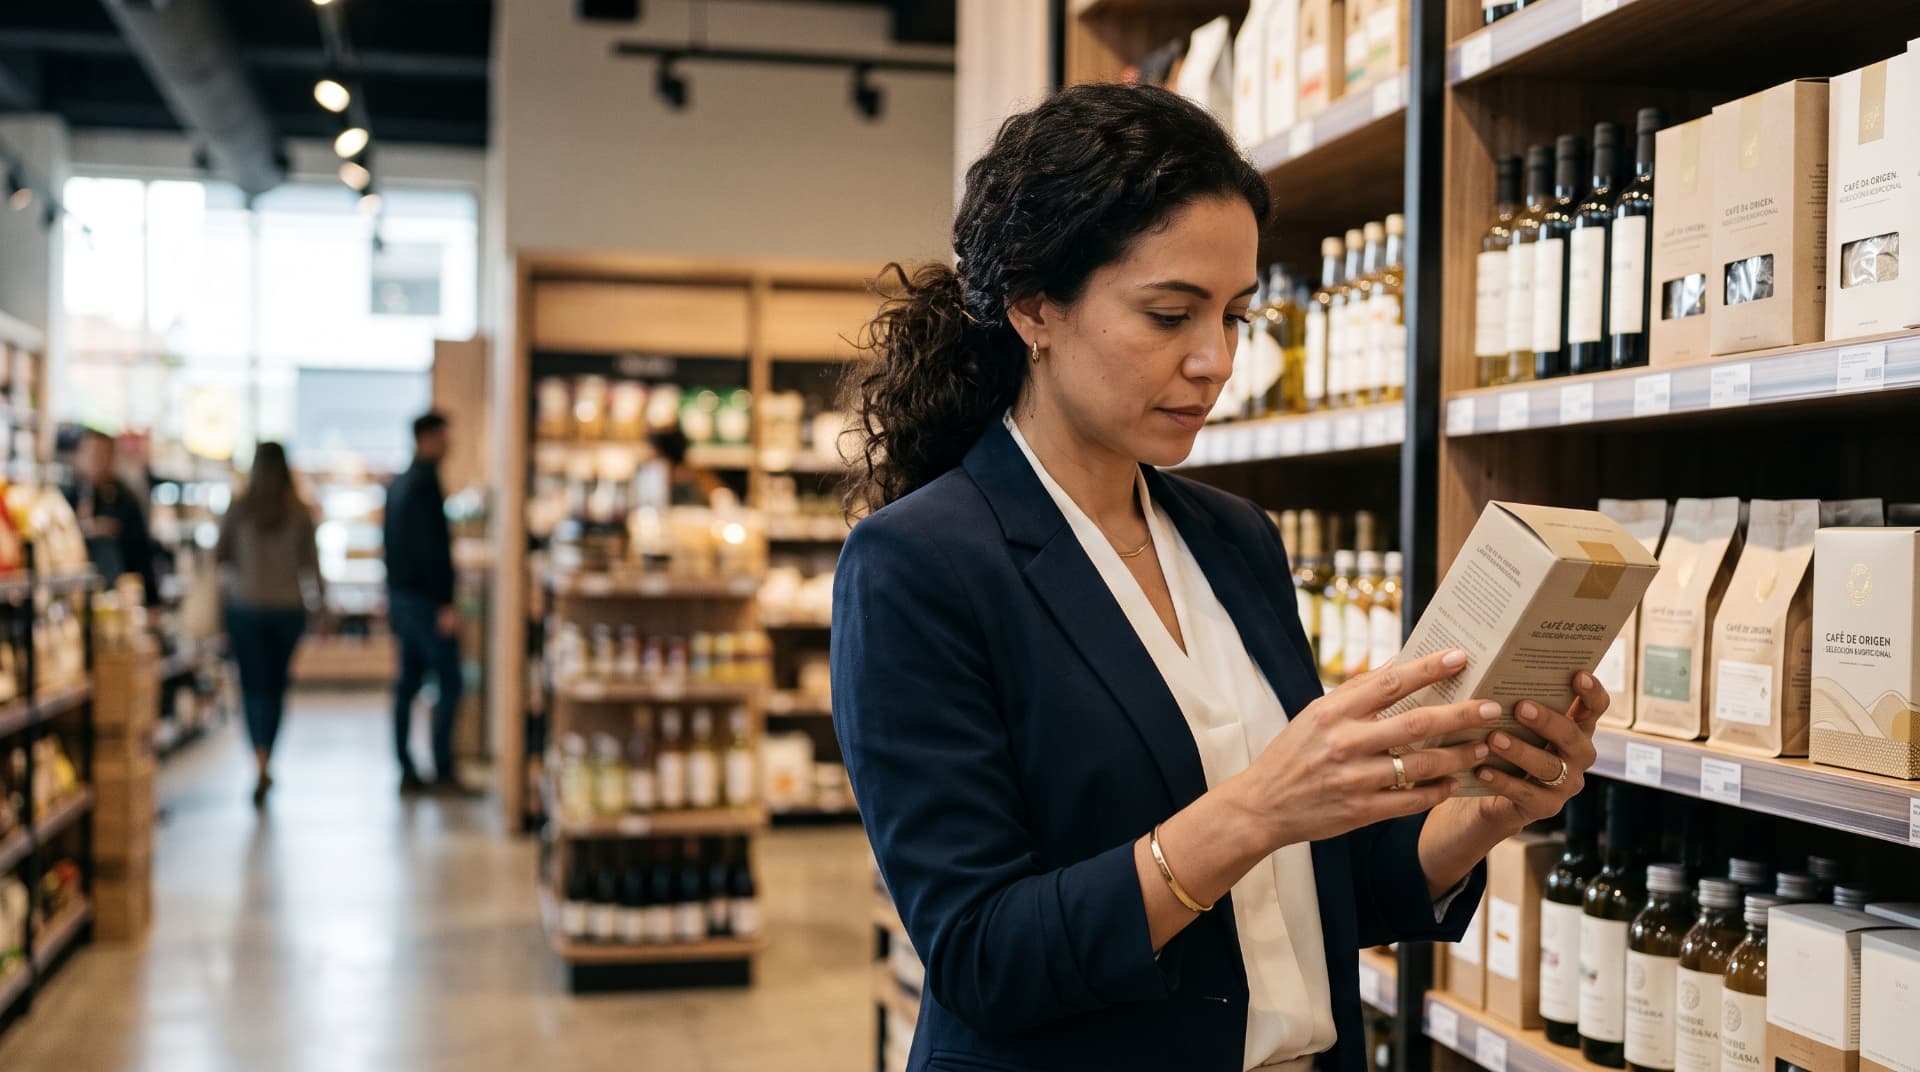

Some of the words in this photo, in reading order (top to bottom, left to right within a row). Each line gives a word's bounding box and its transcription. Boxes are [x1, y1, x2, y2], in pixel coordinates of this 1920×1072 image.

[1540, 620, 1564, 630] CAFÉ
[1562, 622, 1576, 631] DE
[1575, 623, 1607, 632] ORIGEN
[1825, 630, 1845, 644] CAFÉ
[1846, 634, 1857, 645] DE
[1858, 635, 1891, 647] ORIGEN
